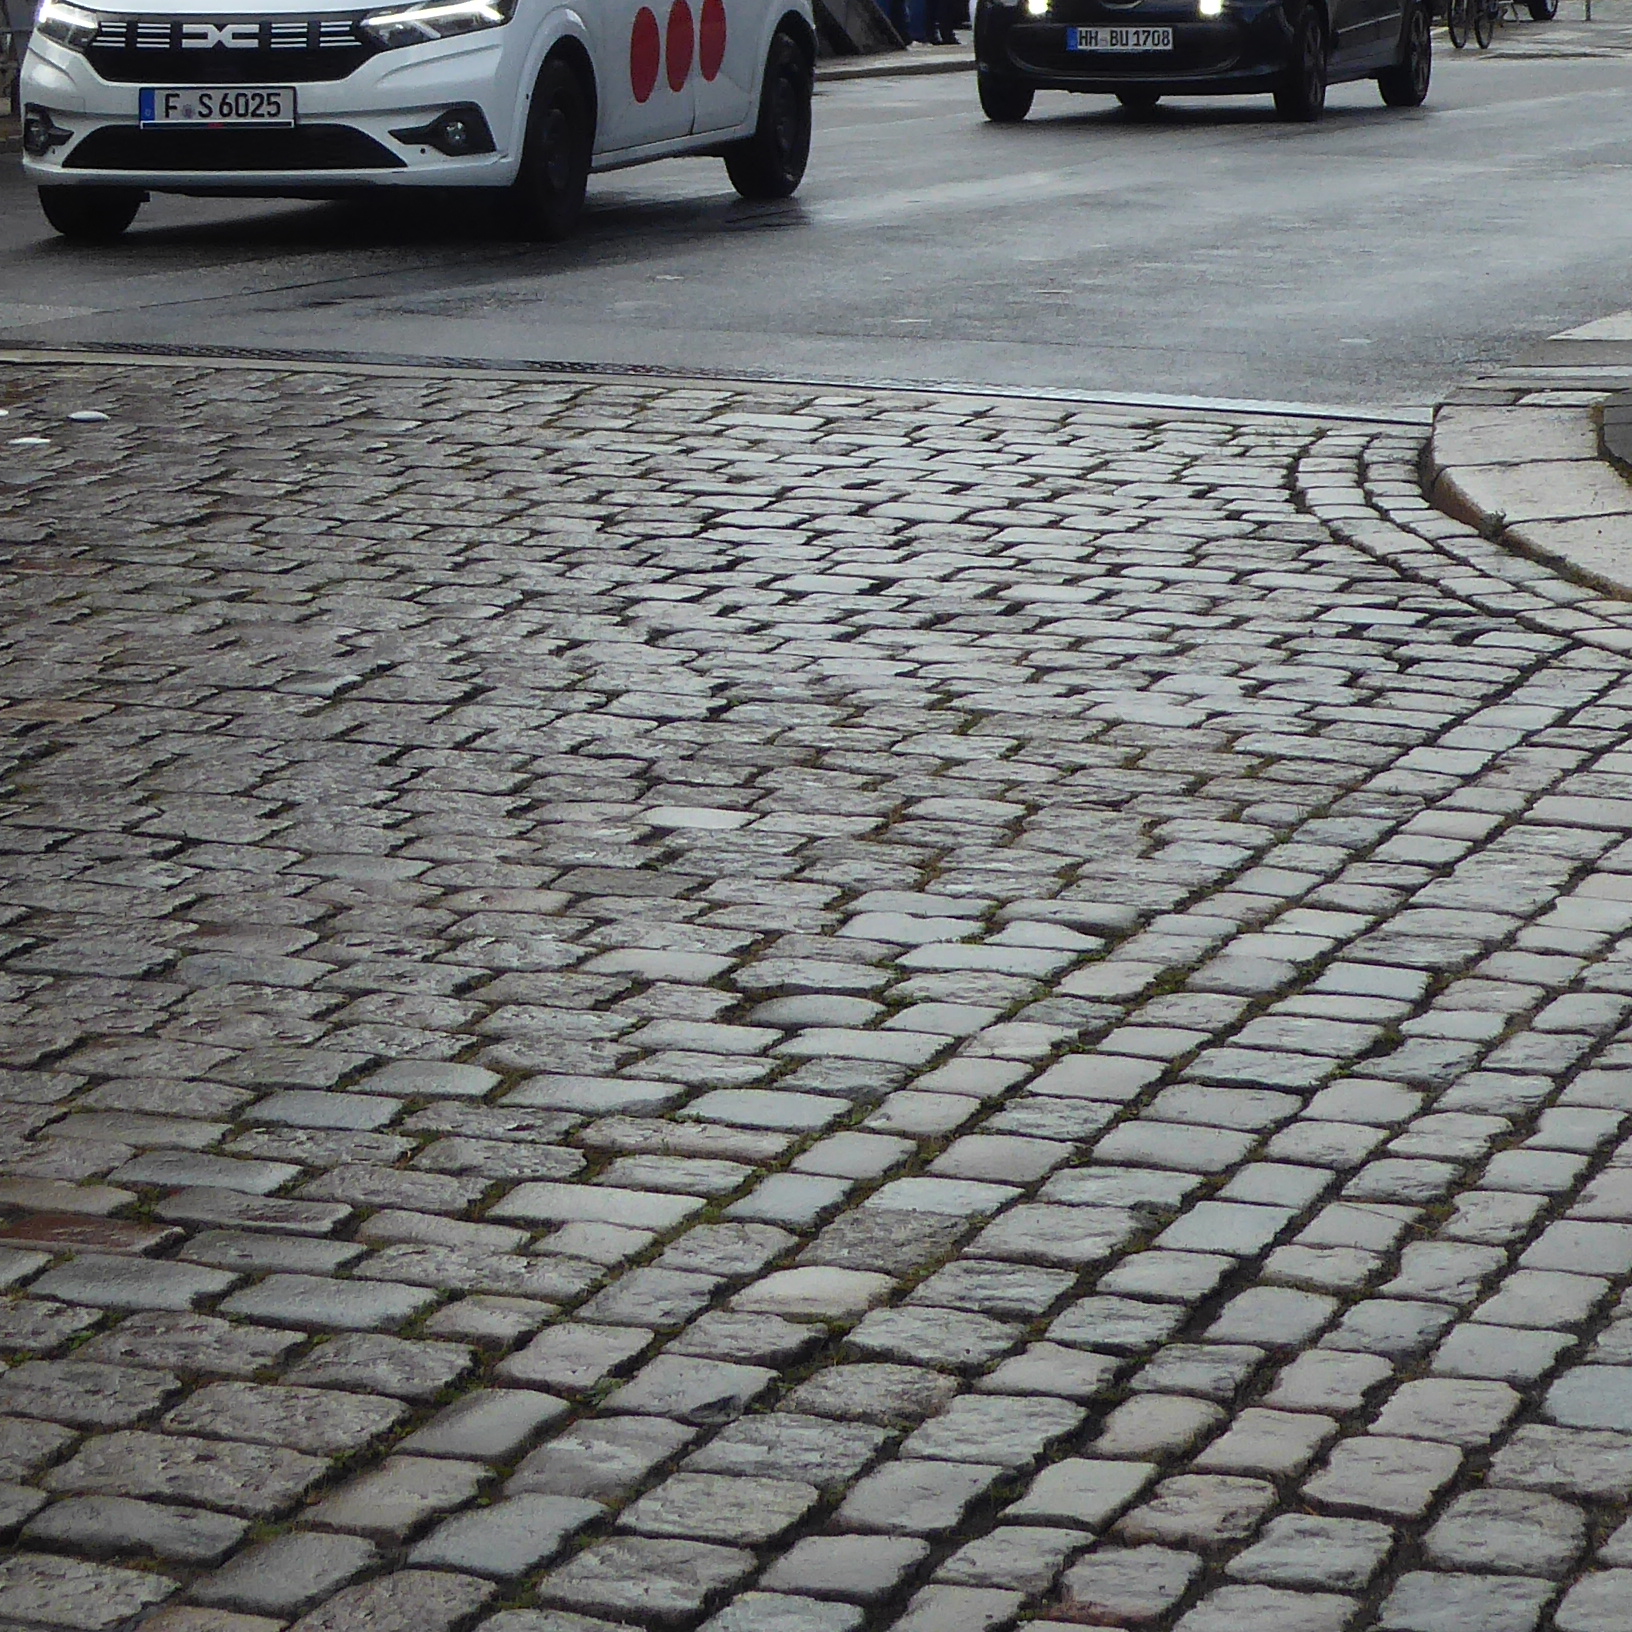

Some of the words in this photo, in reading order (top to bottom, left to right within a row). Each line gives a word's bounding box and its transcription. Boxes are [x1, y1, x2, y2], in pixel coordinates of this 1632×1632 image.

[1078, 30, 1099, 47] HH
[1110, 30, 1129, 46] BU
[1132, 30, 1171, 46] 1708
[164, 93, 180, 118] F
[197, 93, 214, 118] S
[219, 92, 281, 118] 6025
